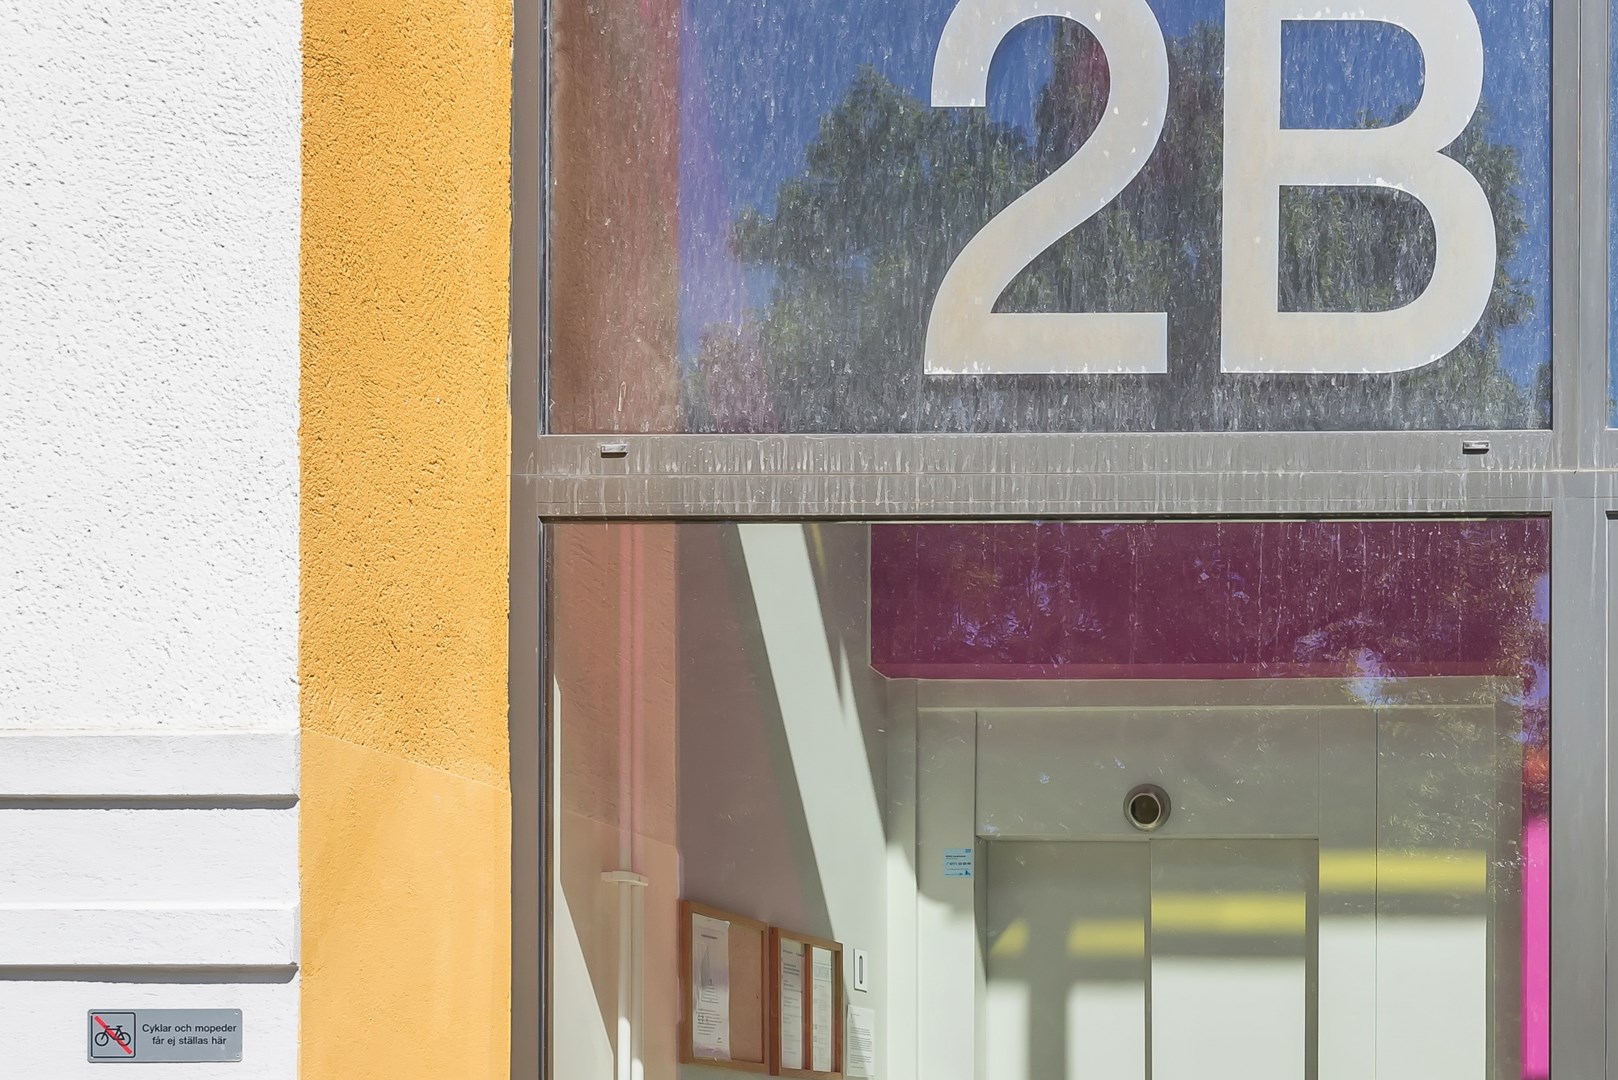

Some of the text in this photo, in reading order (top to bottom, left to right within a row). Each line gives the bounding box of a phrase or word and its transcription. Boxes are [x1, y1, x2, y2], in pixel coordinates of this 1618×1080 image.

[924, 0, 1497, 375] 2B
[142, 1023, 237, 1034] Cyklar och mopeder
[152, 1036, 227, 1046] får ej ställas här
